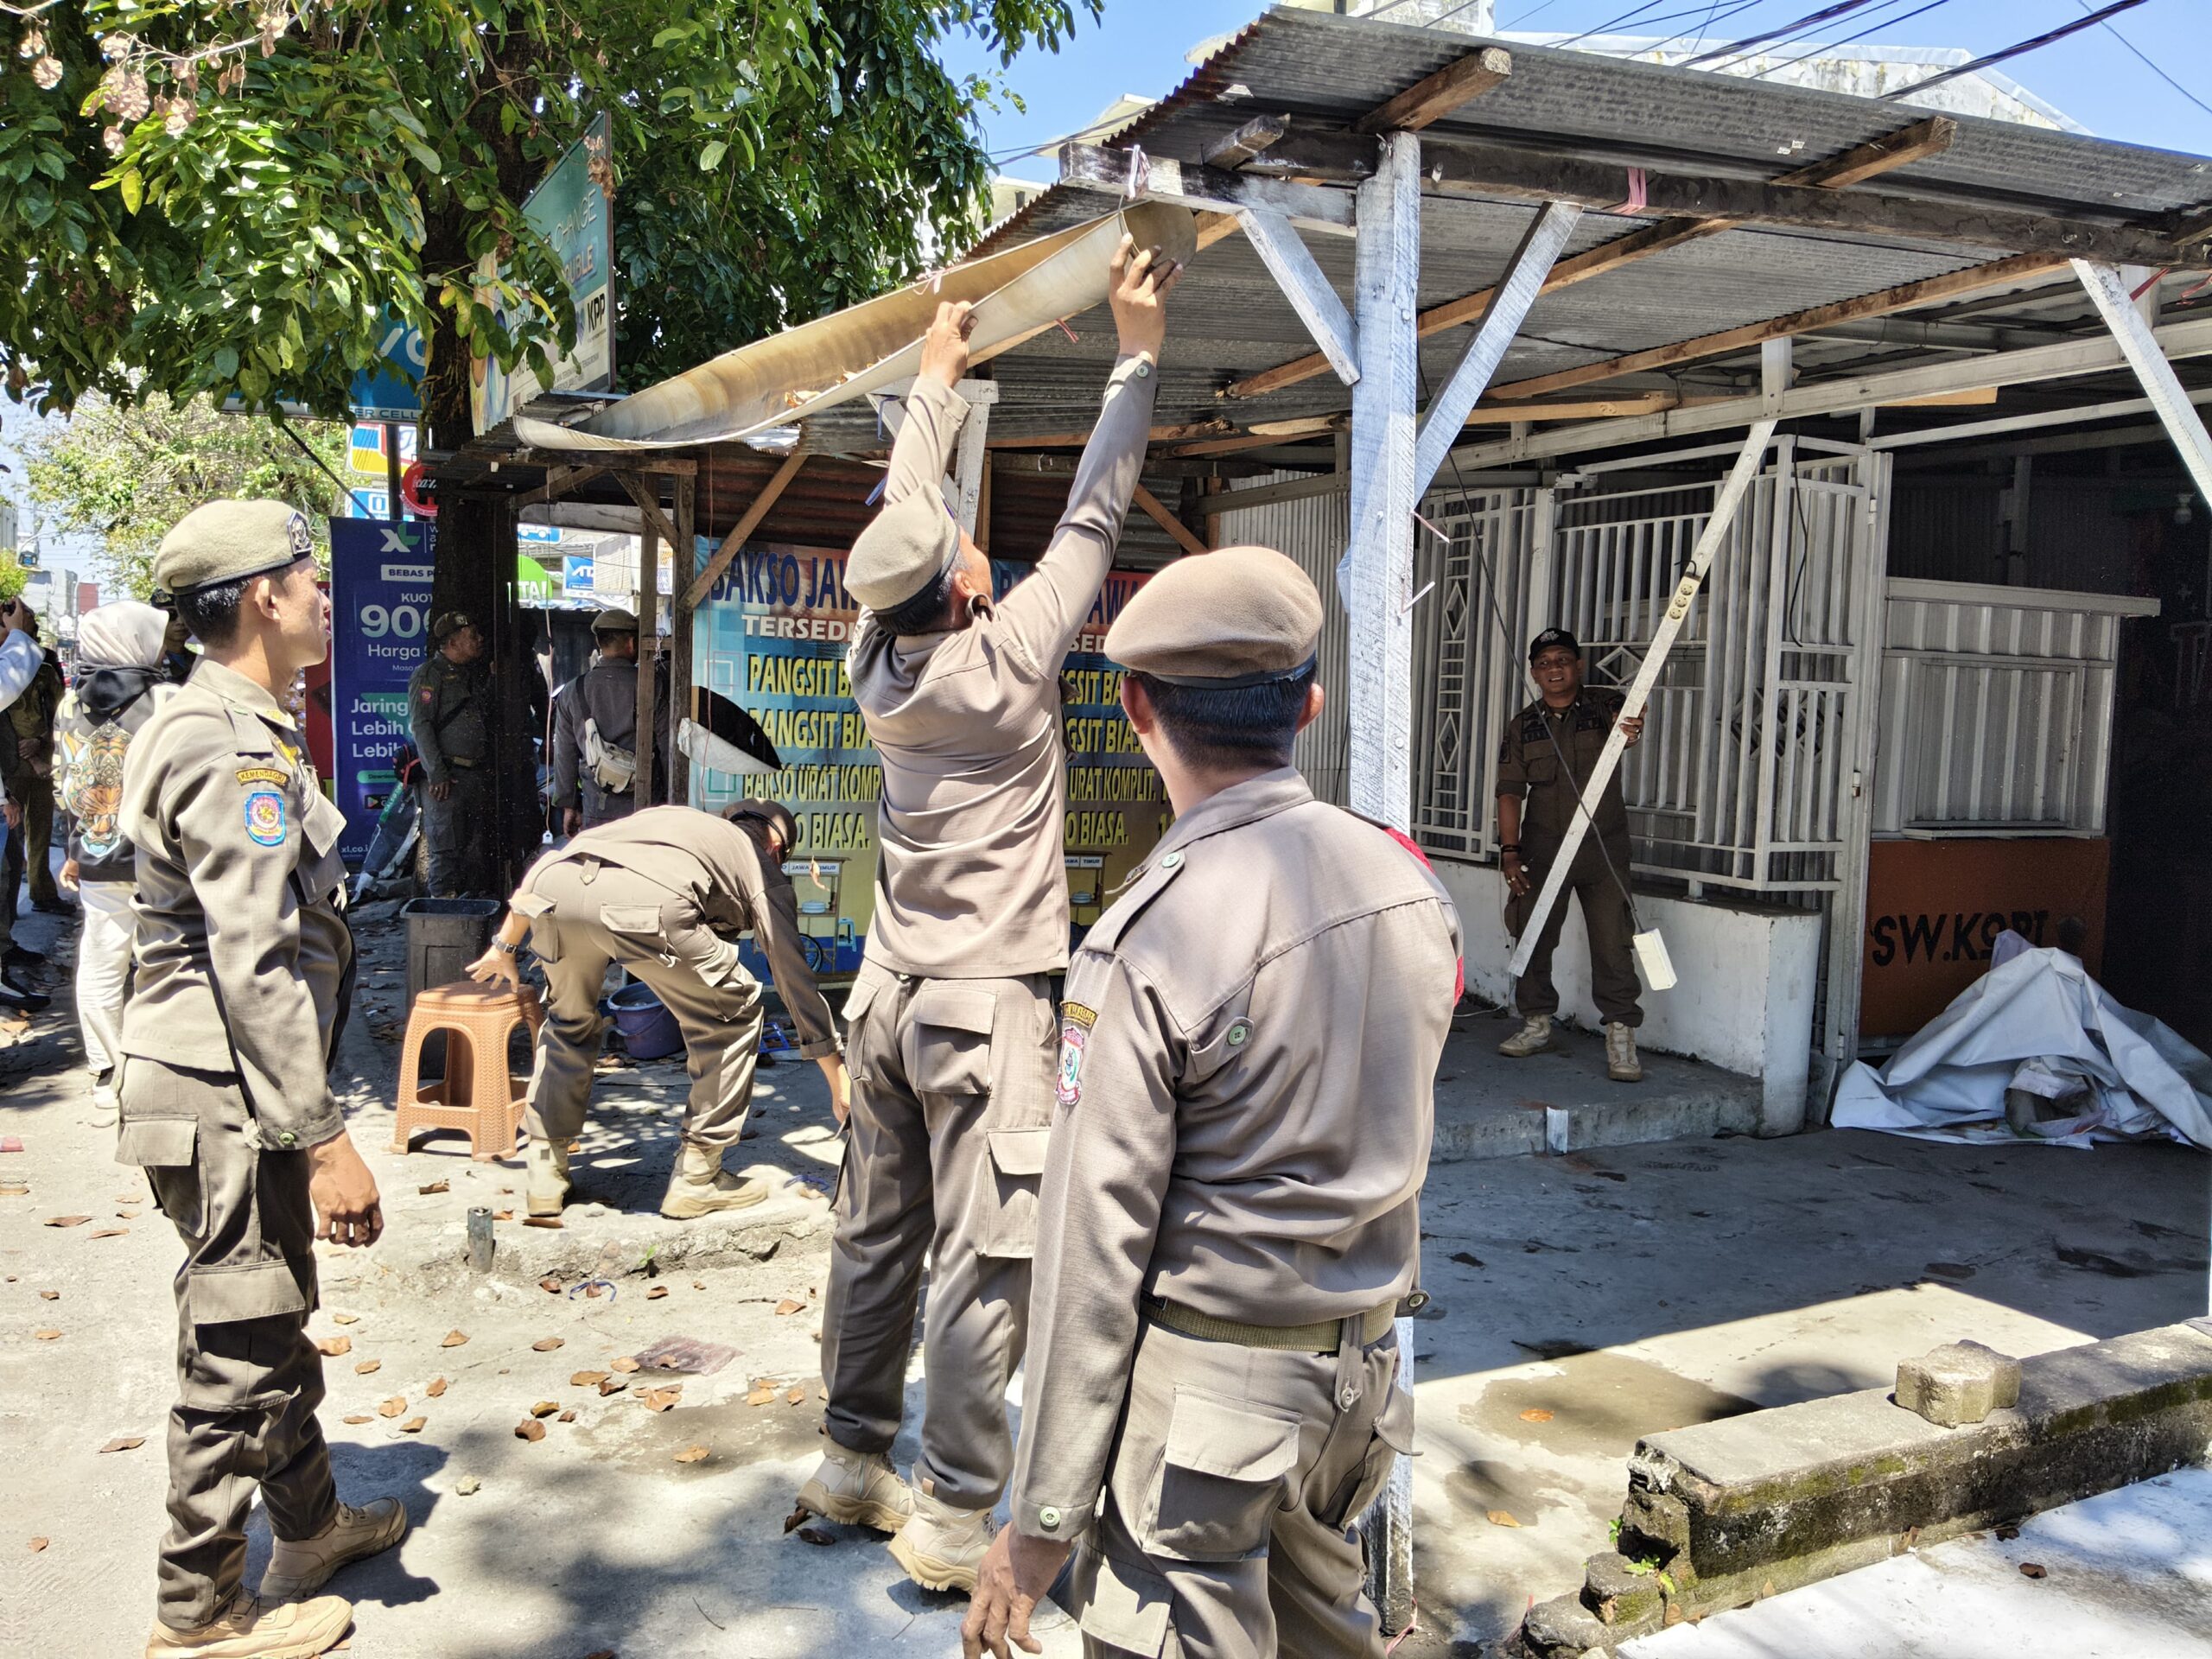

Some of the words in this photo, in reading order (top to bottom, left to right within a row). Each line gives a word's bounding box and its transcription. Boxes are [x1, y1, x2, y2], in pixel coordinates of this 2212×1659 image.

[588, 293, 605, 332] KPP
[389, 569, 424, 577] BEBAS
[360, 605, 431, 638] 90
[367, 644, 420, 660] Harga
[748, 654, 836, 697] PANGSIT
[352, 721, 404, 735] Lebih
[744, 764, 796, 802] BAKSO
[798, 766, 838, 803] URAT
[1070, 767, 1103, 802] URAT
[810, 813, 871, 851] BIASA.
[1080, 811, 1129, 847] BIASA.
